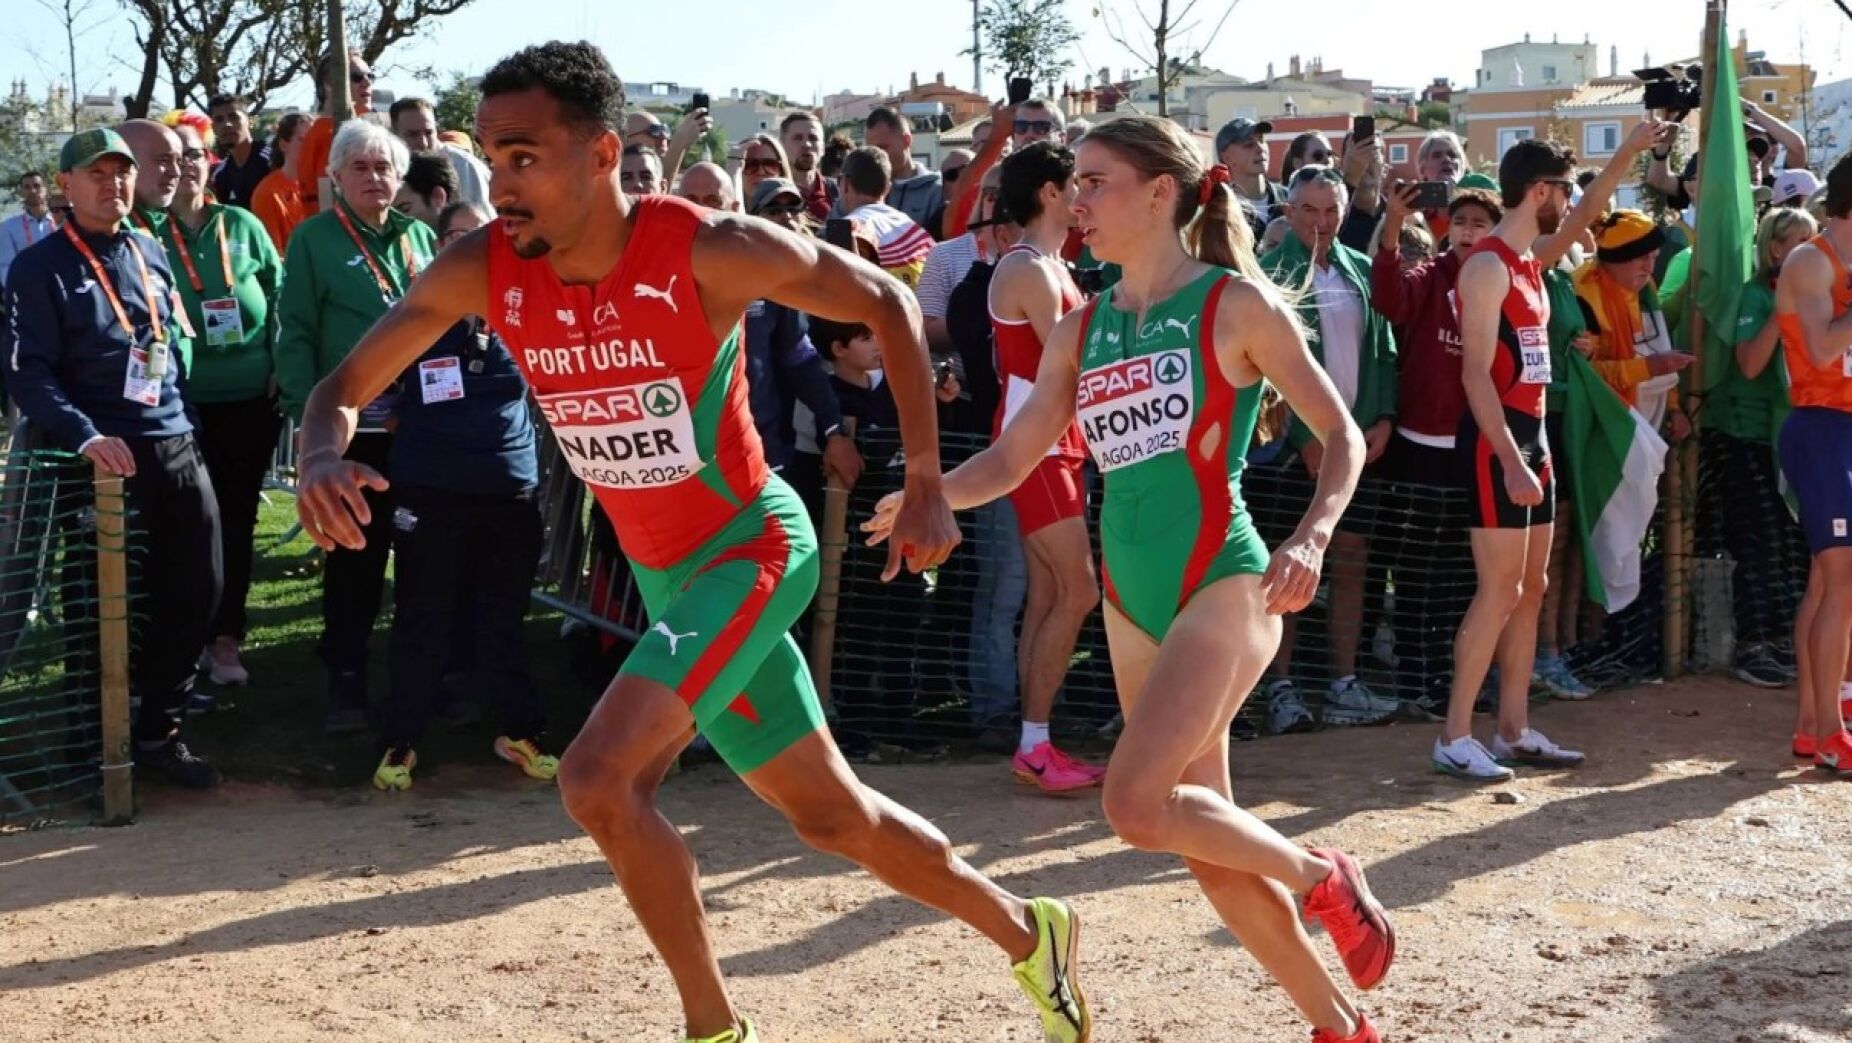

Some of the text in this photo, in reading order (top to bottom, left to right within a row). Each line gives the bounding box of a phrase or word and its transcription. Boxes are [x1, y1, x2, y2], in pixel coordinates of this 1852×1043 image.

[524, 338, 666, 376] PORTUGAL
[1077, 362, 1151, 405] SPAR
[538, 393, 641, 424] SPAR
[1083, 393, 1190, 445] AFONSO
[559, 428, 682, 462] NADER
[1100, 430, 1181, 469] AGOA 2025
[581, 464, 690, 485] AGOA 2025
